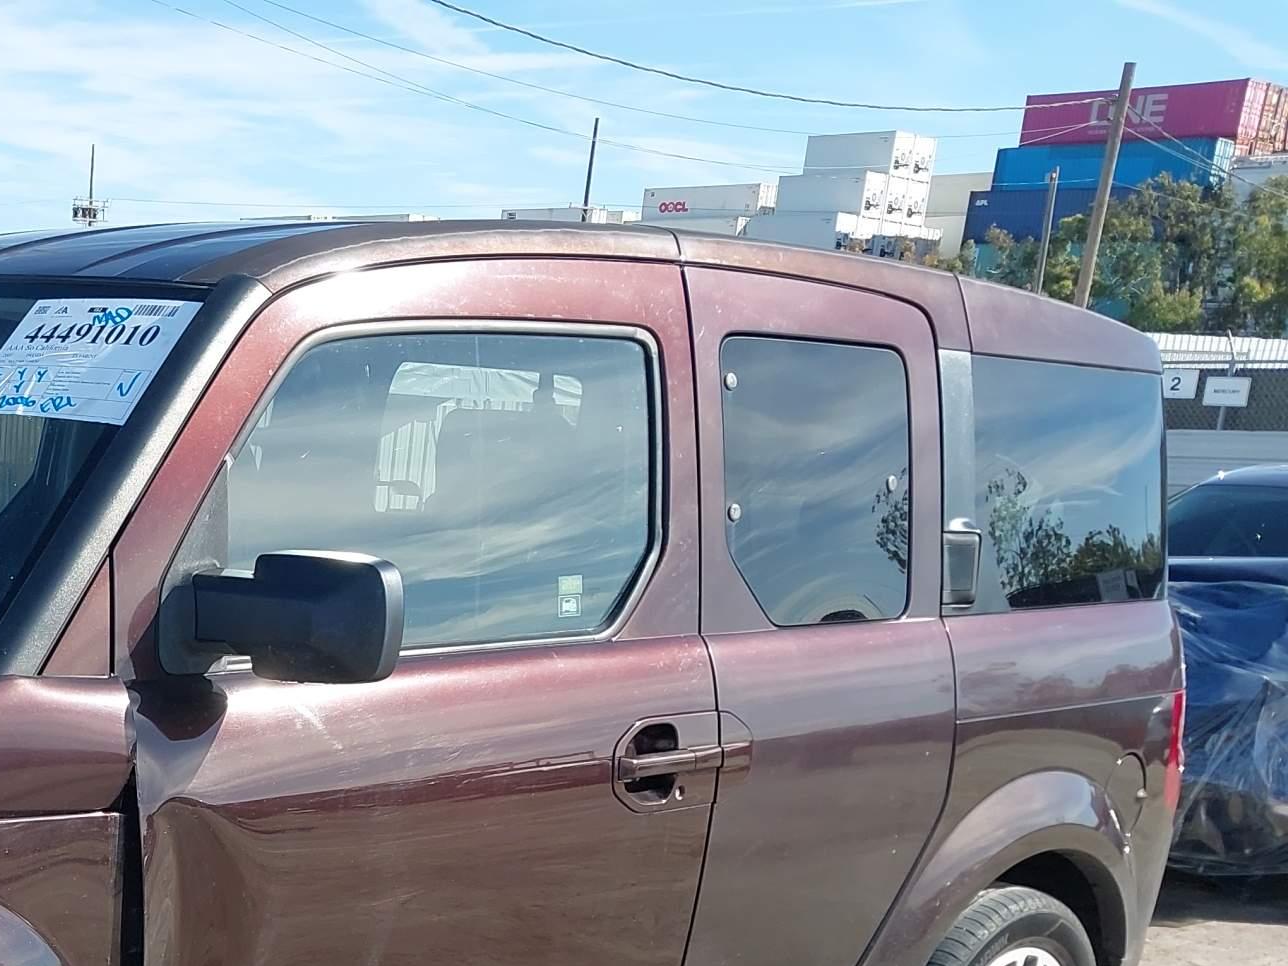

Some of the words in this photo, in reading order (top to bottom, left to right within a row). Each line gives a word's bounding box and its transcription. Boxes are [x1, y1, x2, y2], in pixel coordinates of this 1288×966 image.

[659, 201, 688, 213] OOCL
[24, 322, 160, 346] 44491010
[1170, 376, 1182, 391] 2
